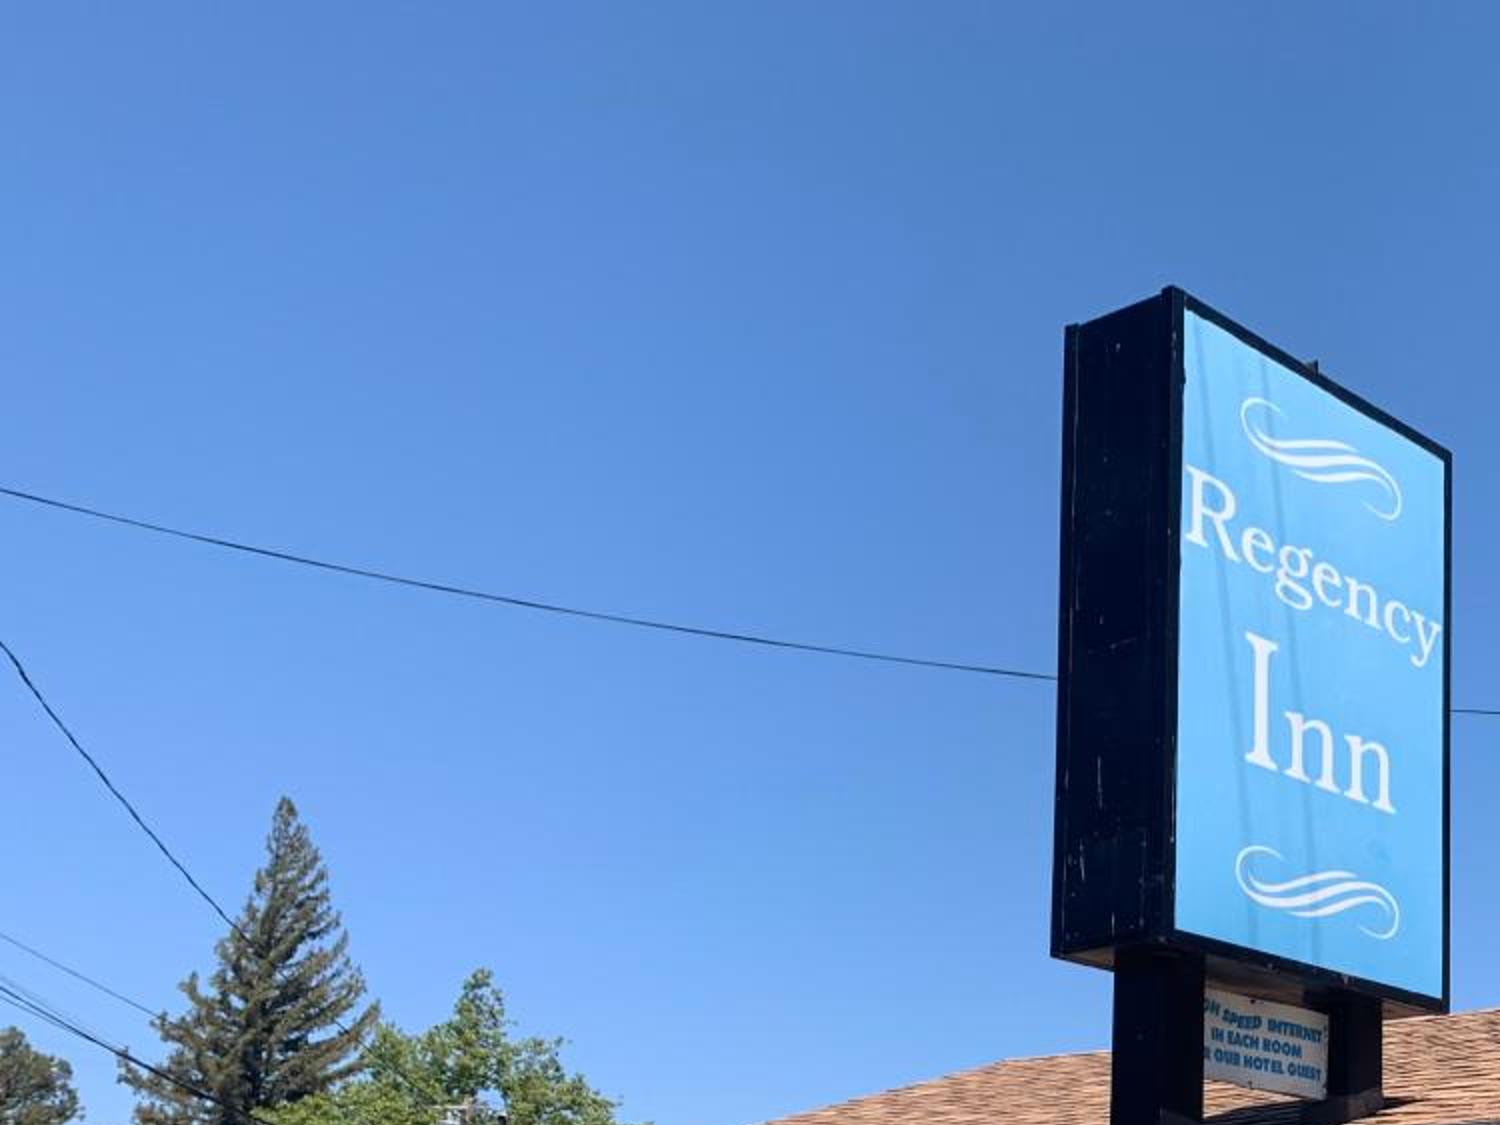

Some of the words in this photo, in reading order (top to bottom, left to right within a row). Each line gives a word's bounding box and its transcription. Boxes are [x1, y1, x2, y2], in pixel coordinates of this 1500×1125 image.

[1185, 464, 1443, 668] Regency
[1244, 631, 1397, 815] Inn
[1222, 1010, 1262, 1029] SPEED
[1268, 1019, 1322, 1042] INTERNET
[1228, 1031, 1259, 1051] EACH
[1264, 1040, 1303, 1058] ROOM
[1214, 1050, 1241, 1067] OUR
[1243, 1056, 1284, 1075] HOTEL
